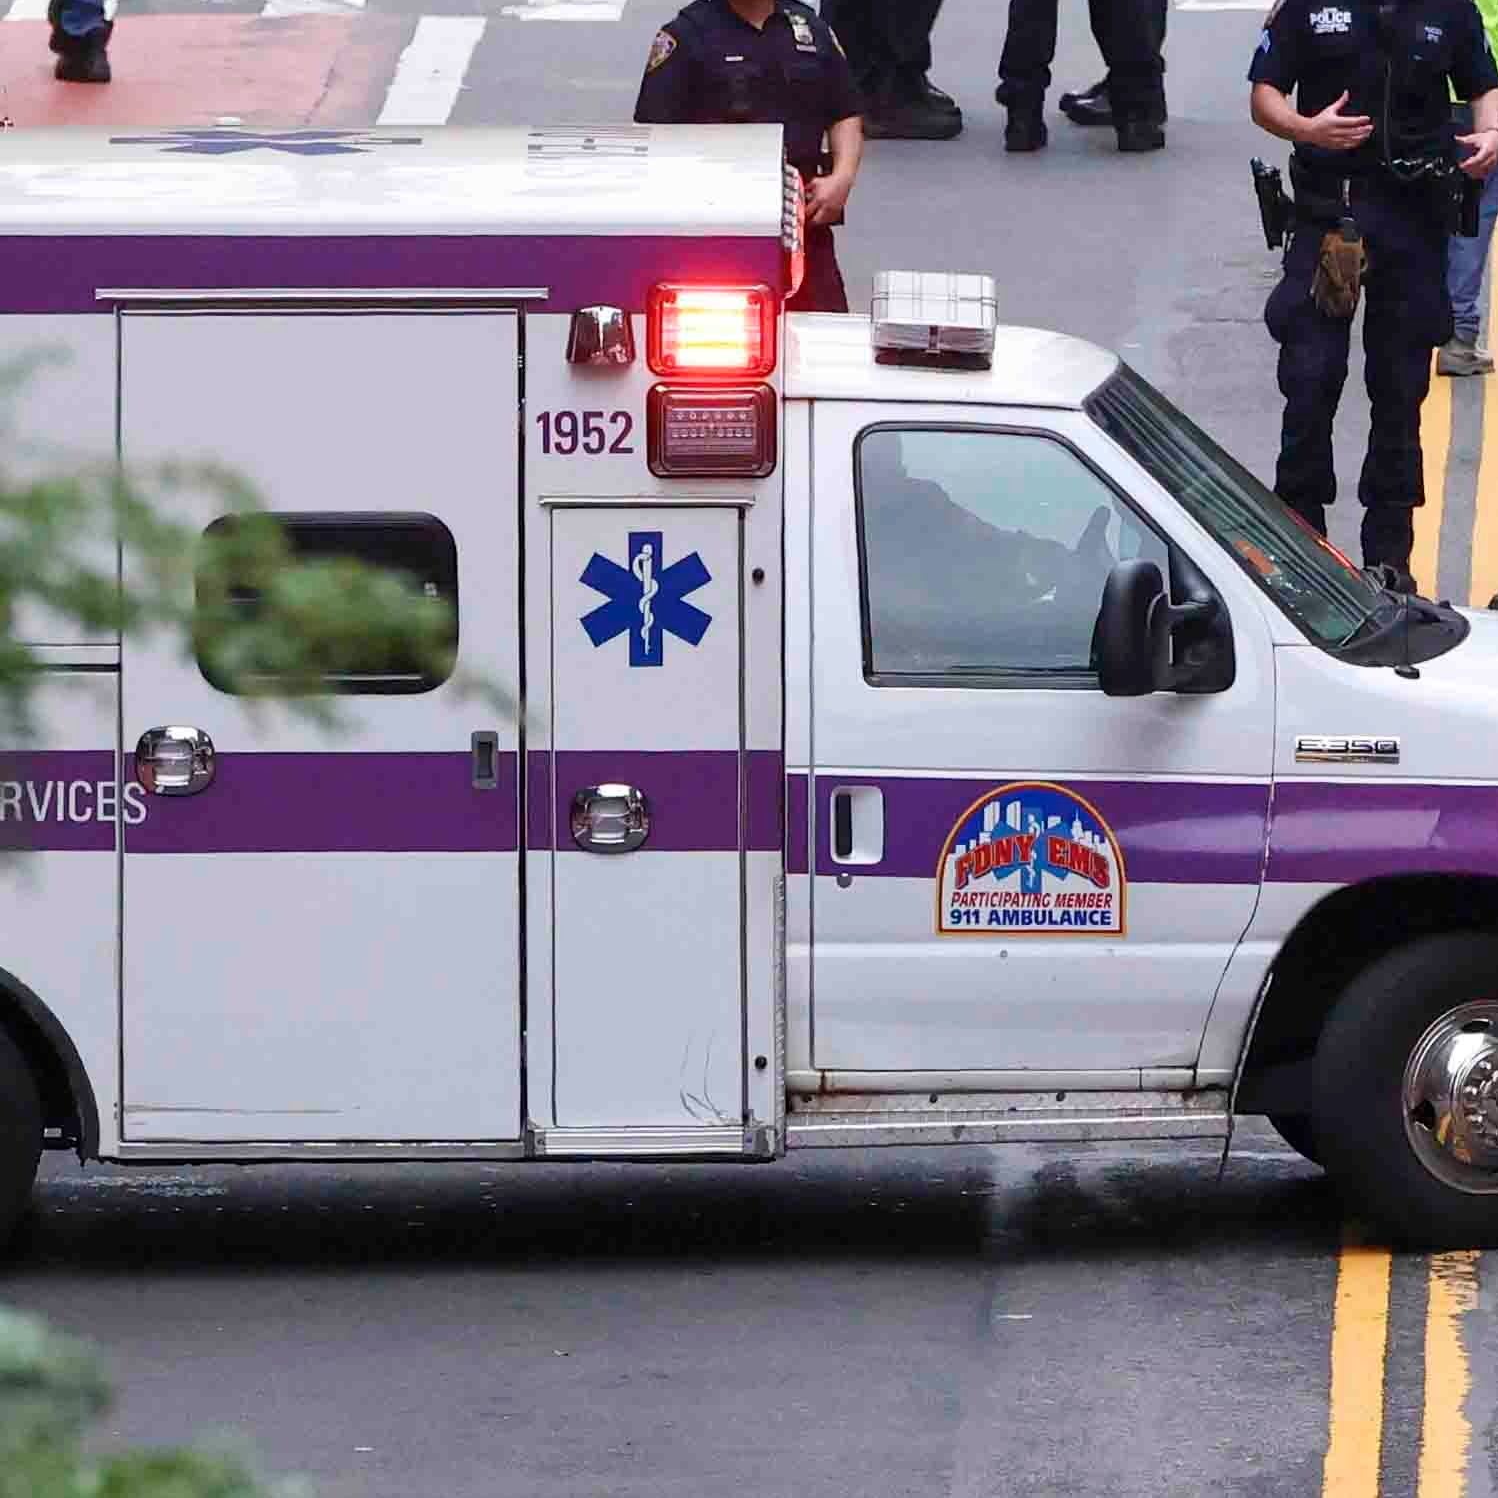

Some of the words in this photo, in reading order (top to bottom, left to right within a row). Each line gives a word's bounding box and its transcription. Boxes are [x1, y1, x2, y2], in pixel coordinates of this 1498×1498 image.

[1310, 11, 1352, 25] POLICE
[536, 410, 635, 455] 1952
[955, 833, 1035, 890] FDNY
[1047, 836, 1111, 890] EMS
[951, 892, 1051, 908] PARTICIPATING
[1054, 892, 1112, 909] MEMBER
[950, 909, 981, 925] 911
[987, 909, 1112, 926] AMBULANCE
